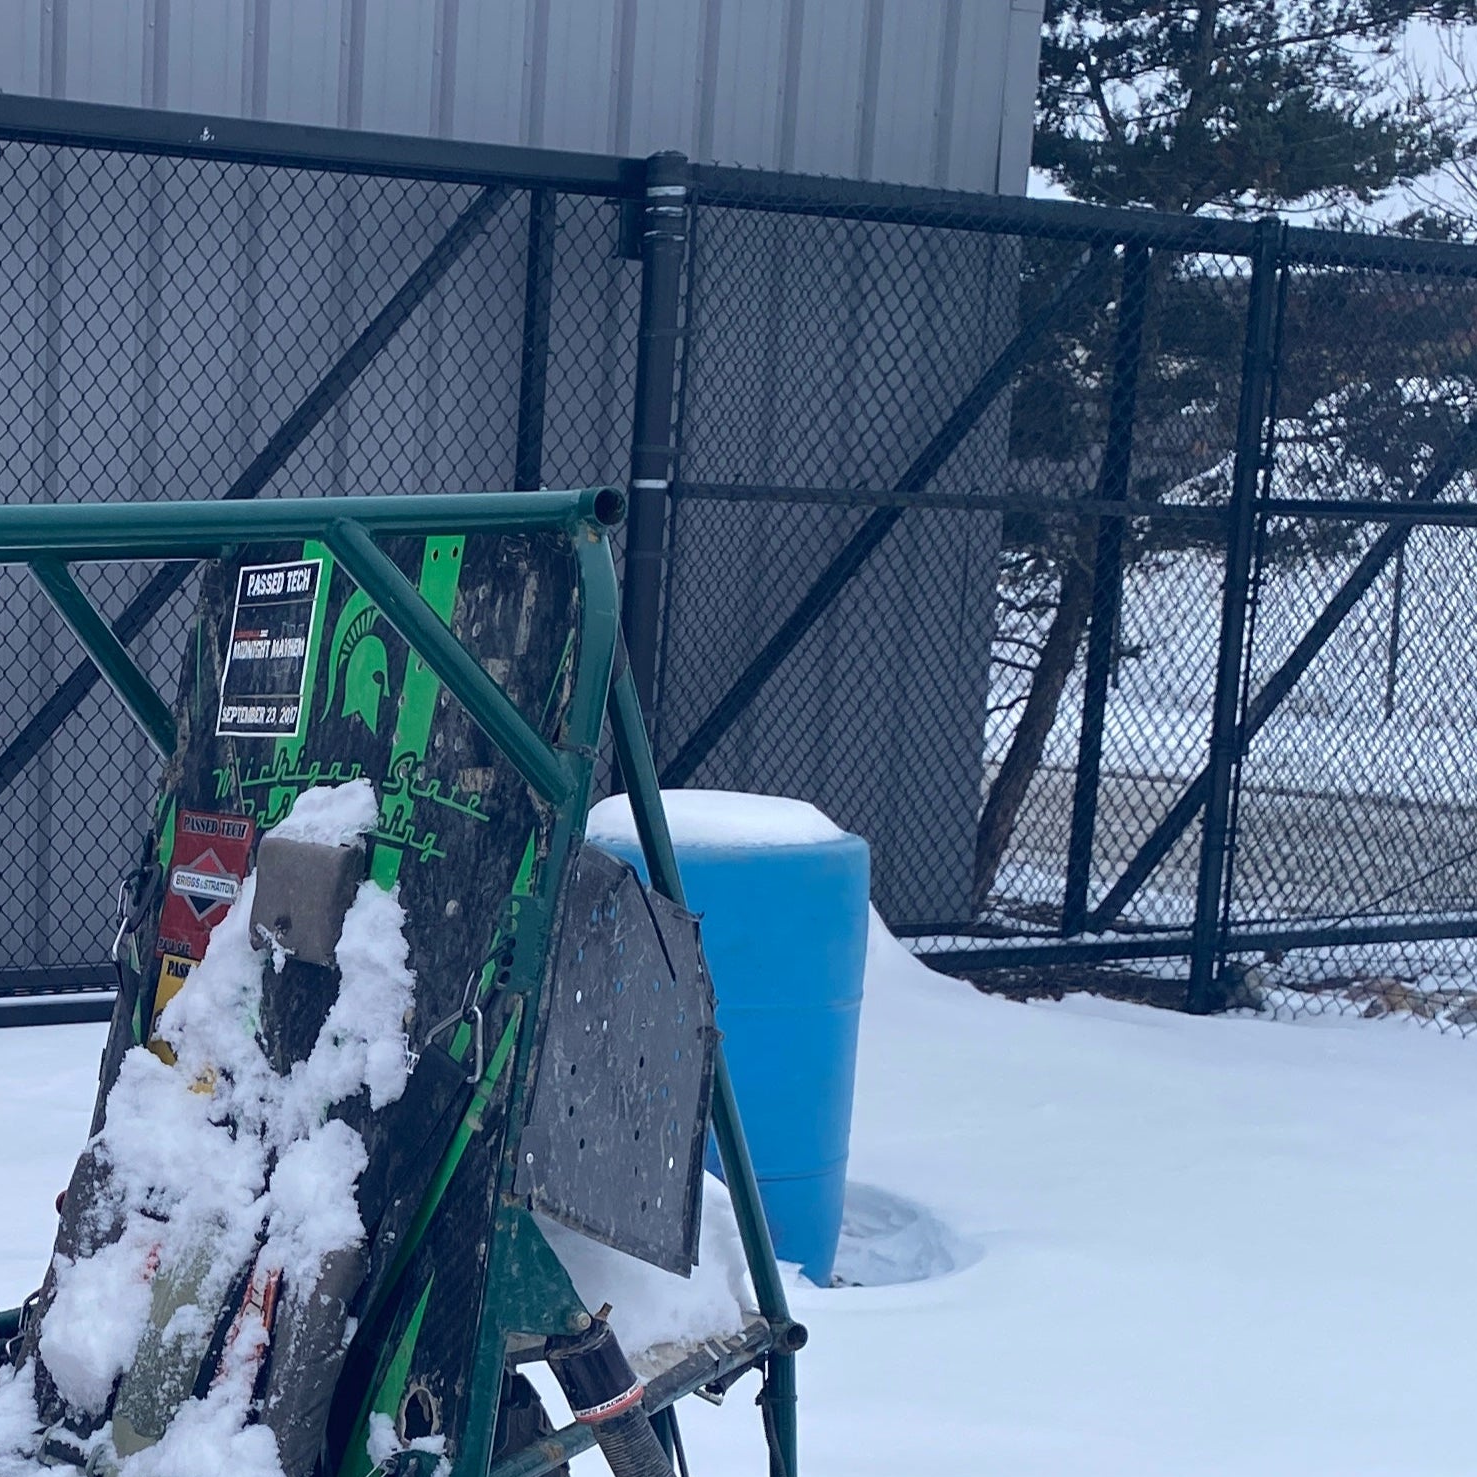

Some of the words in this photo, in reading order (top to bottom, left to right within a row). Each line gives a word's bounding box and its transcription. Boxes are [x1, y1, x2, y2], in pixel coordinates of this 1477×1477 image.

[247, 570, 284, 597] PASSED
[286, 568, 311, 592] TECH
[232, 639, 270, 660] MIDNIGHT
[270, 637, 305, 659] MAYHEM
[221, 706, 265, 724] SEPTEMBER
[279, 705, 298, 725] 2017
[212, 749, 368, 798] Michigan
[382, 752, 490, 822] State
[183, 815, 220, 836] PASSED
[220, 819, 249, 840] TECH
[176, 874, 200, 889] BRIGGS
[204, 879, 235, 895] STRATTON
